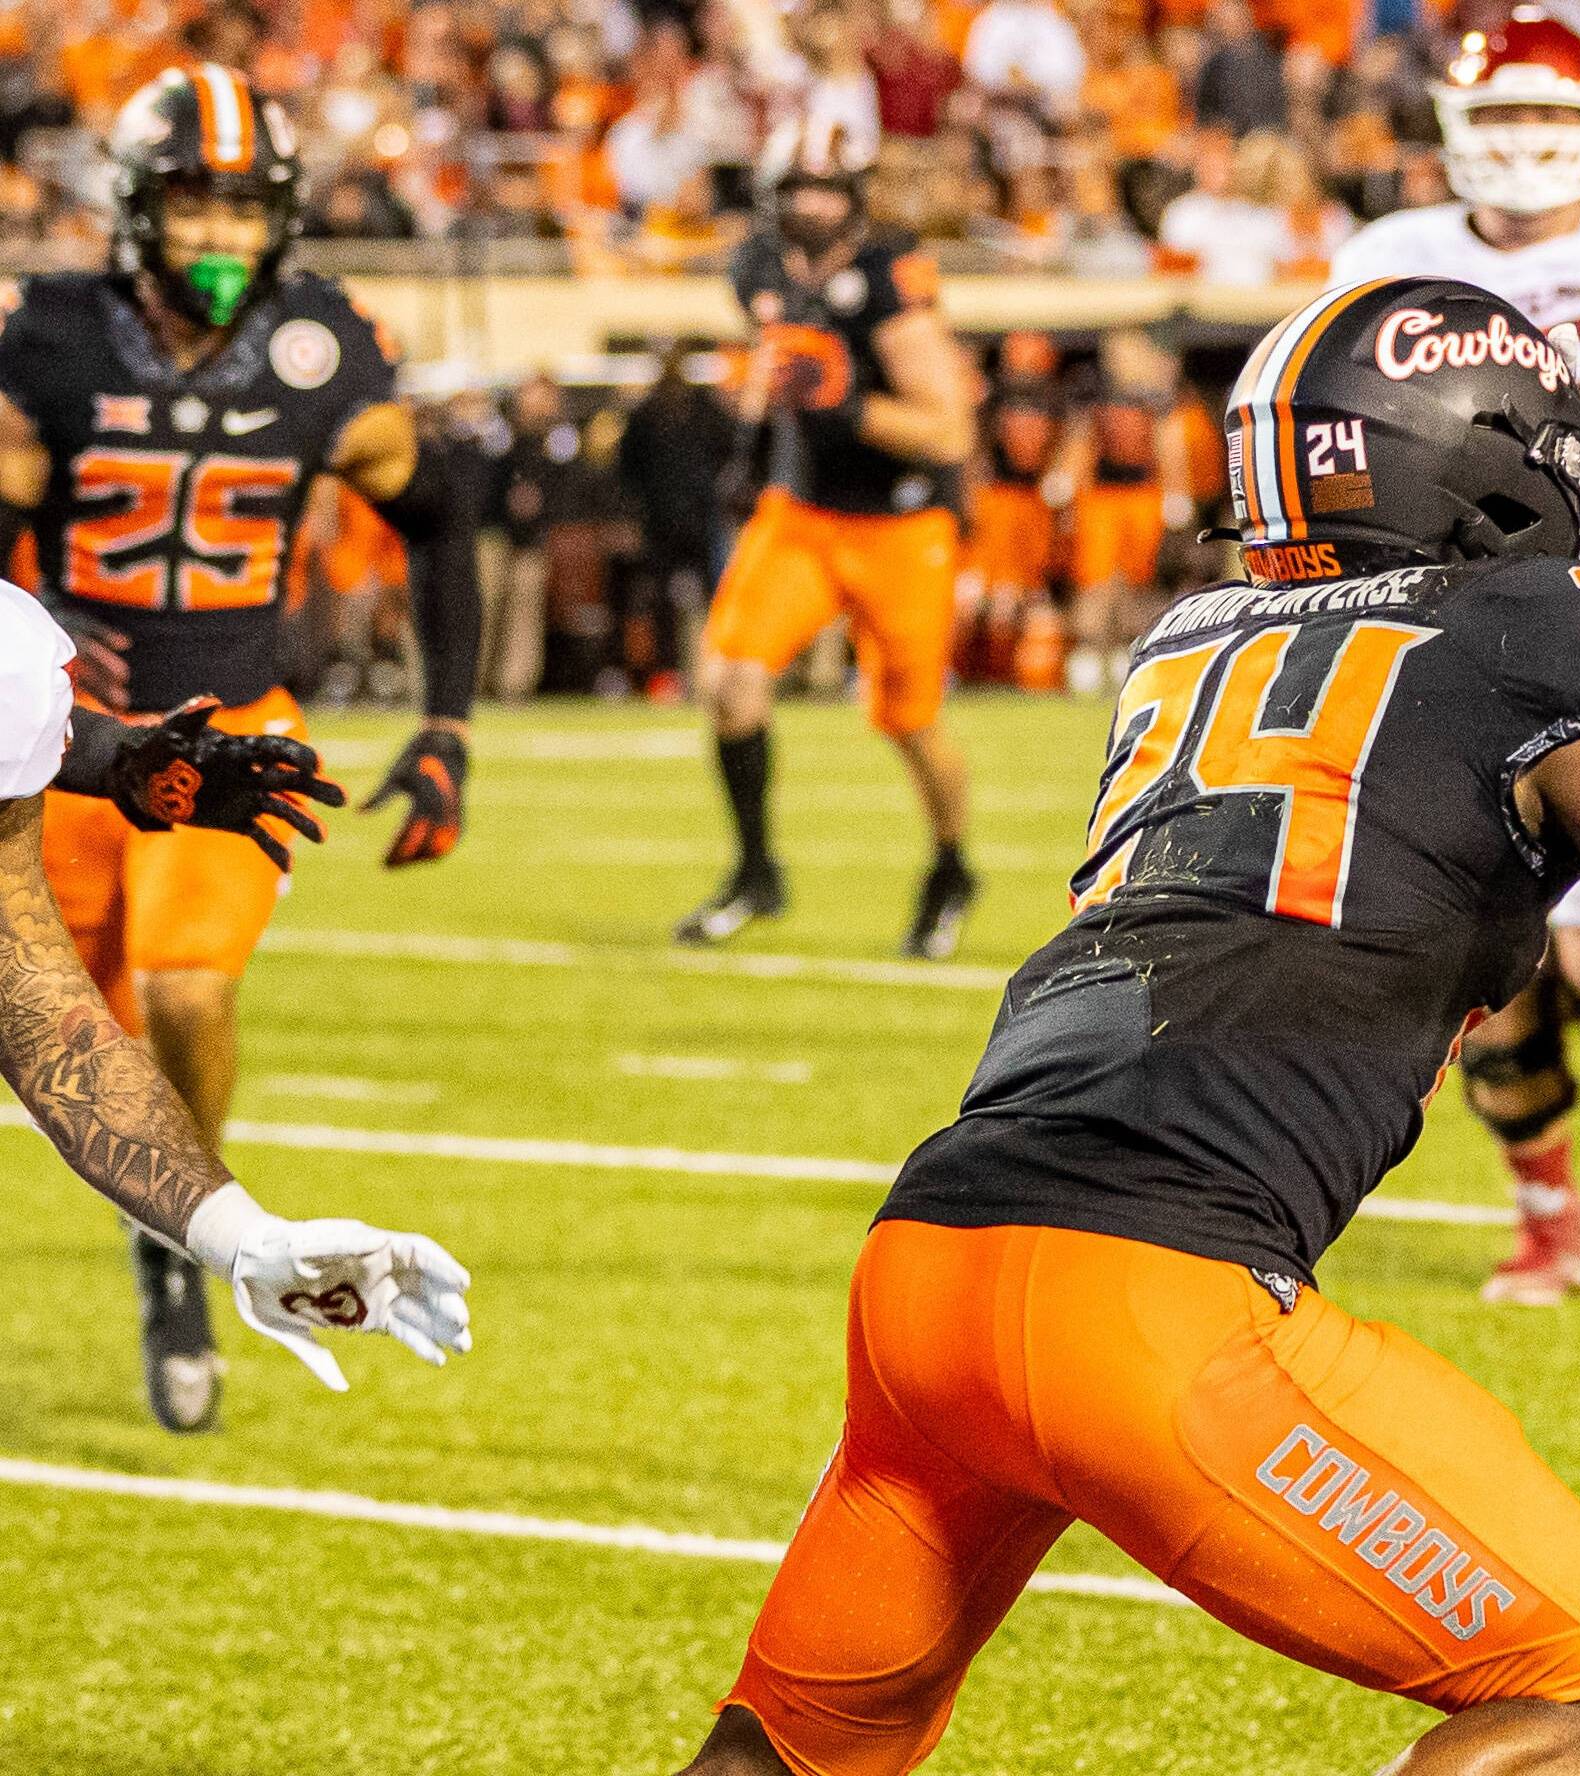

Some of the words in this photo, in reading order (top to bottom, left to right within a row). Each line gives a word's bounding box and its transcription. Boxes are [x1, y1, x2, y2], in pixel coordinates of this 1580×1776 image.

[1376, 308, 1571, 392] Cowboys
[1306, 418, 1368, 476] 24
[64, 450, 300, 611] 25
[1069, 619, 1444, 930] 24
[1255, 1423, 1517, 1642] COWBOYS
